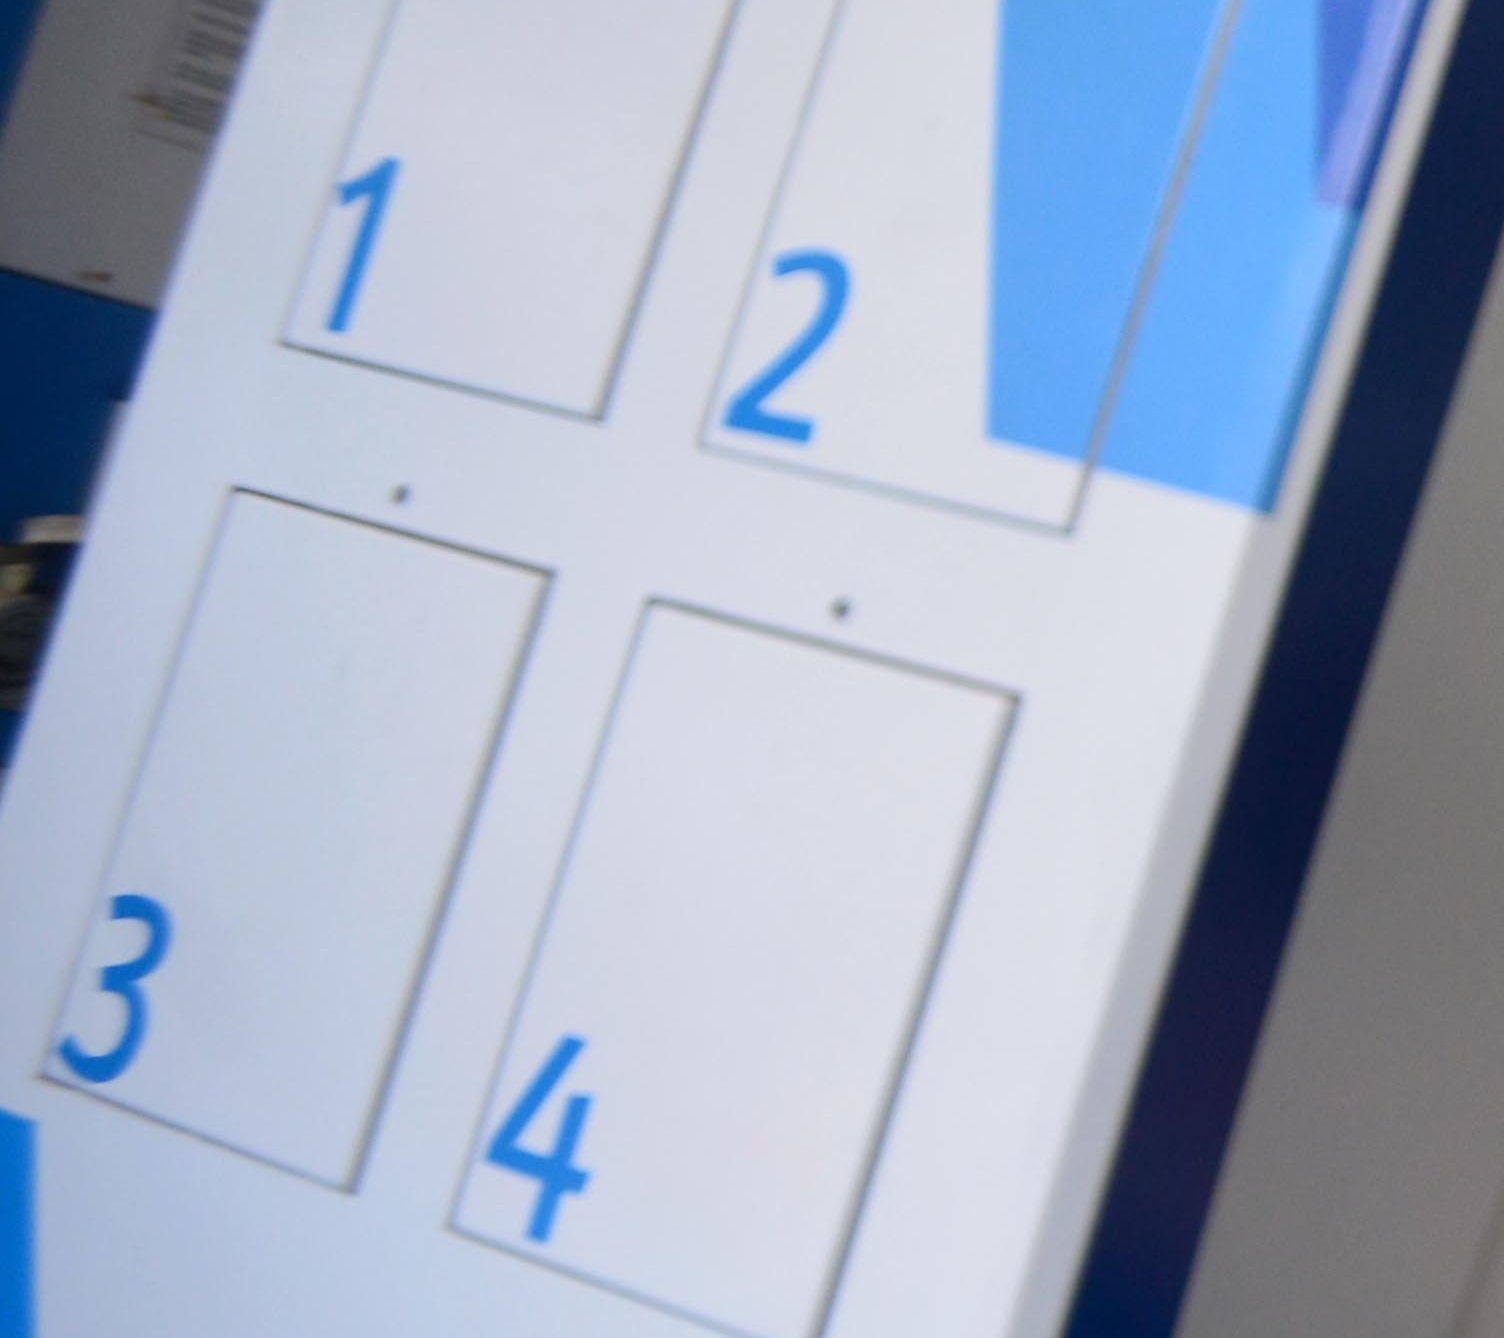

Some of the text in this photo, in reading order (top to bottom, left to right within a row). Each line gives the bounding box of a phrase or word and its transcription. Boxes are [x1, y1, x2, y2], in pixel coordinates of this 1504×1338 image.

[327, 156, 402, 332] 1
[721, 247, 852, 444] 2
[57, 893, 173, 1083] 3
[484, 1033, 595, 1244] 4
